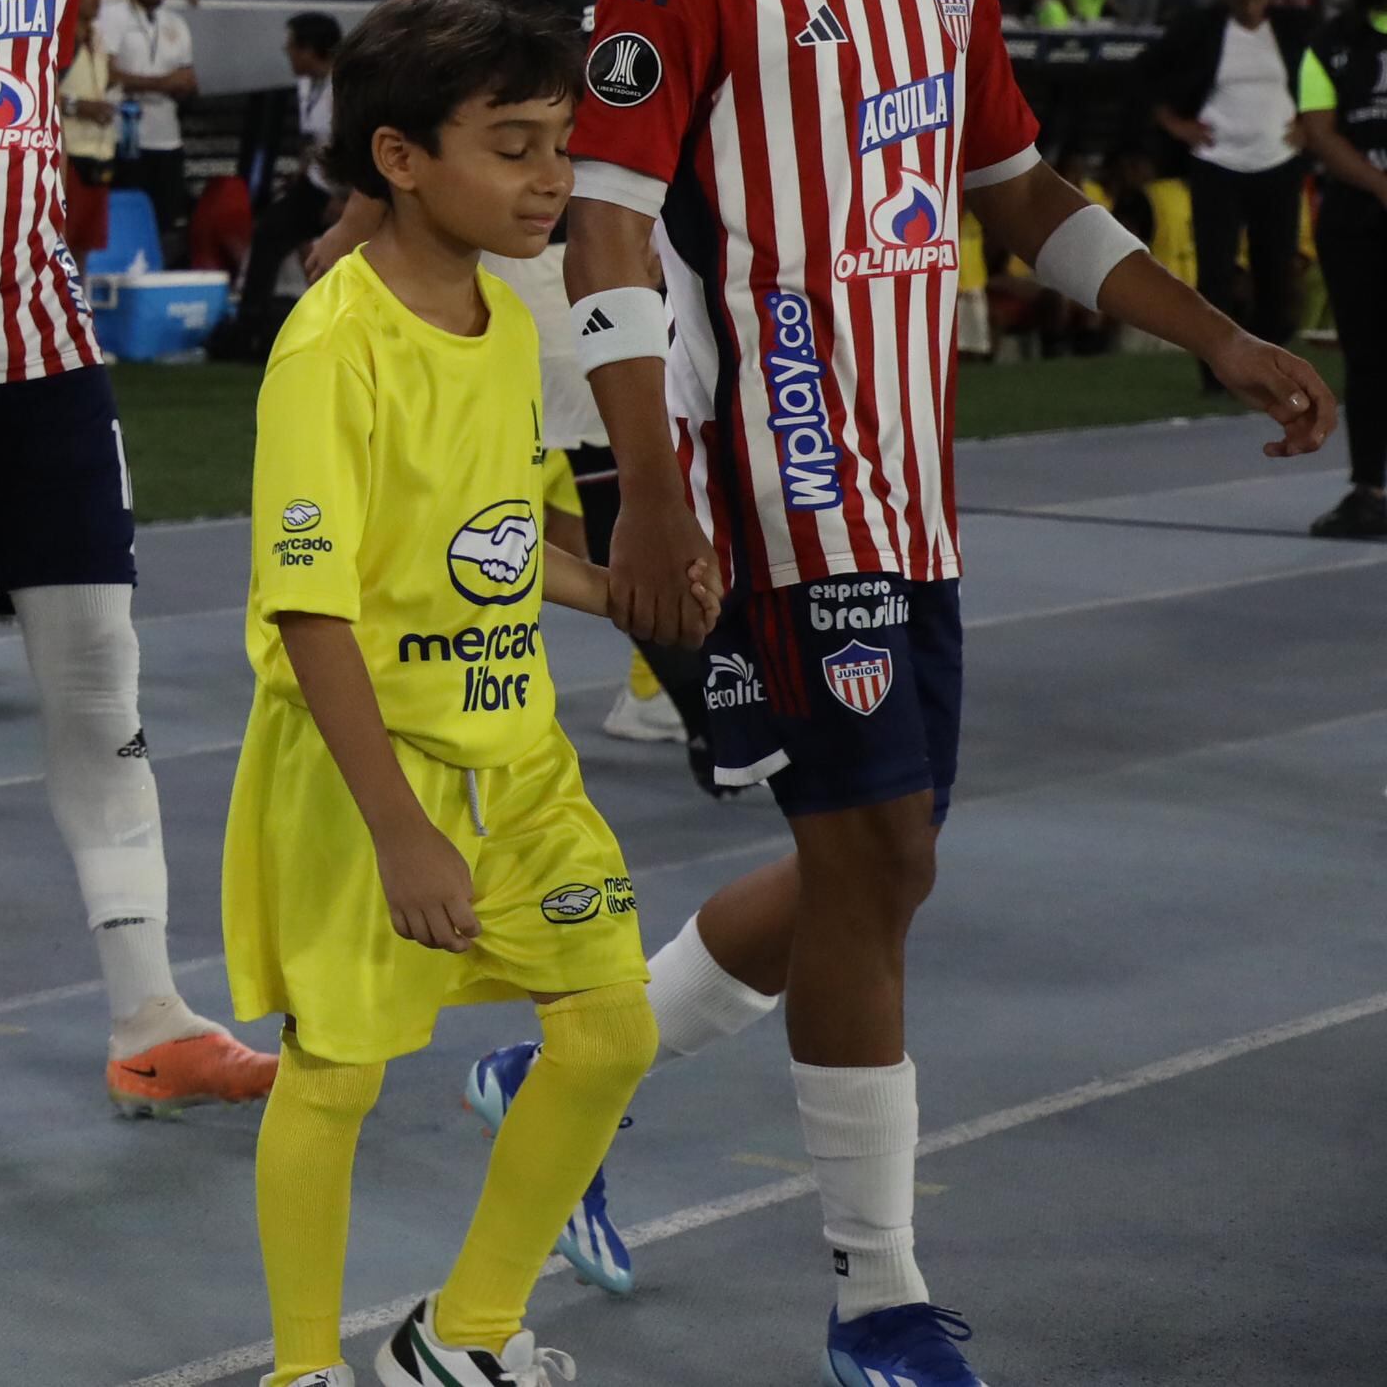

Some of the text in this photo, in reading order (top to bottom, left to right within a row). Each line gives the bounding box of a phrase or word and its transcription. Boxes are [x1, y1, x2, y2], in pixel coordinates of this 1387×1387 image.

[859, 90, 949, 153] AGUILA
[272, 536, 333, 555] mercado
[280, 552, 314, 567] libre
[808, 580, 891, 603] expreso
[399, 622, 539, 662] merca
[836, 665, 881, 679] JUNIOR
[461, 665, 530, 712] libre
[604, 876, 633, 894] merc
[606, 894, 637, 915] libre
